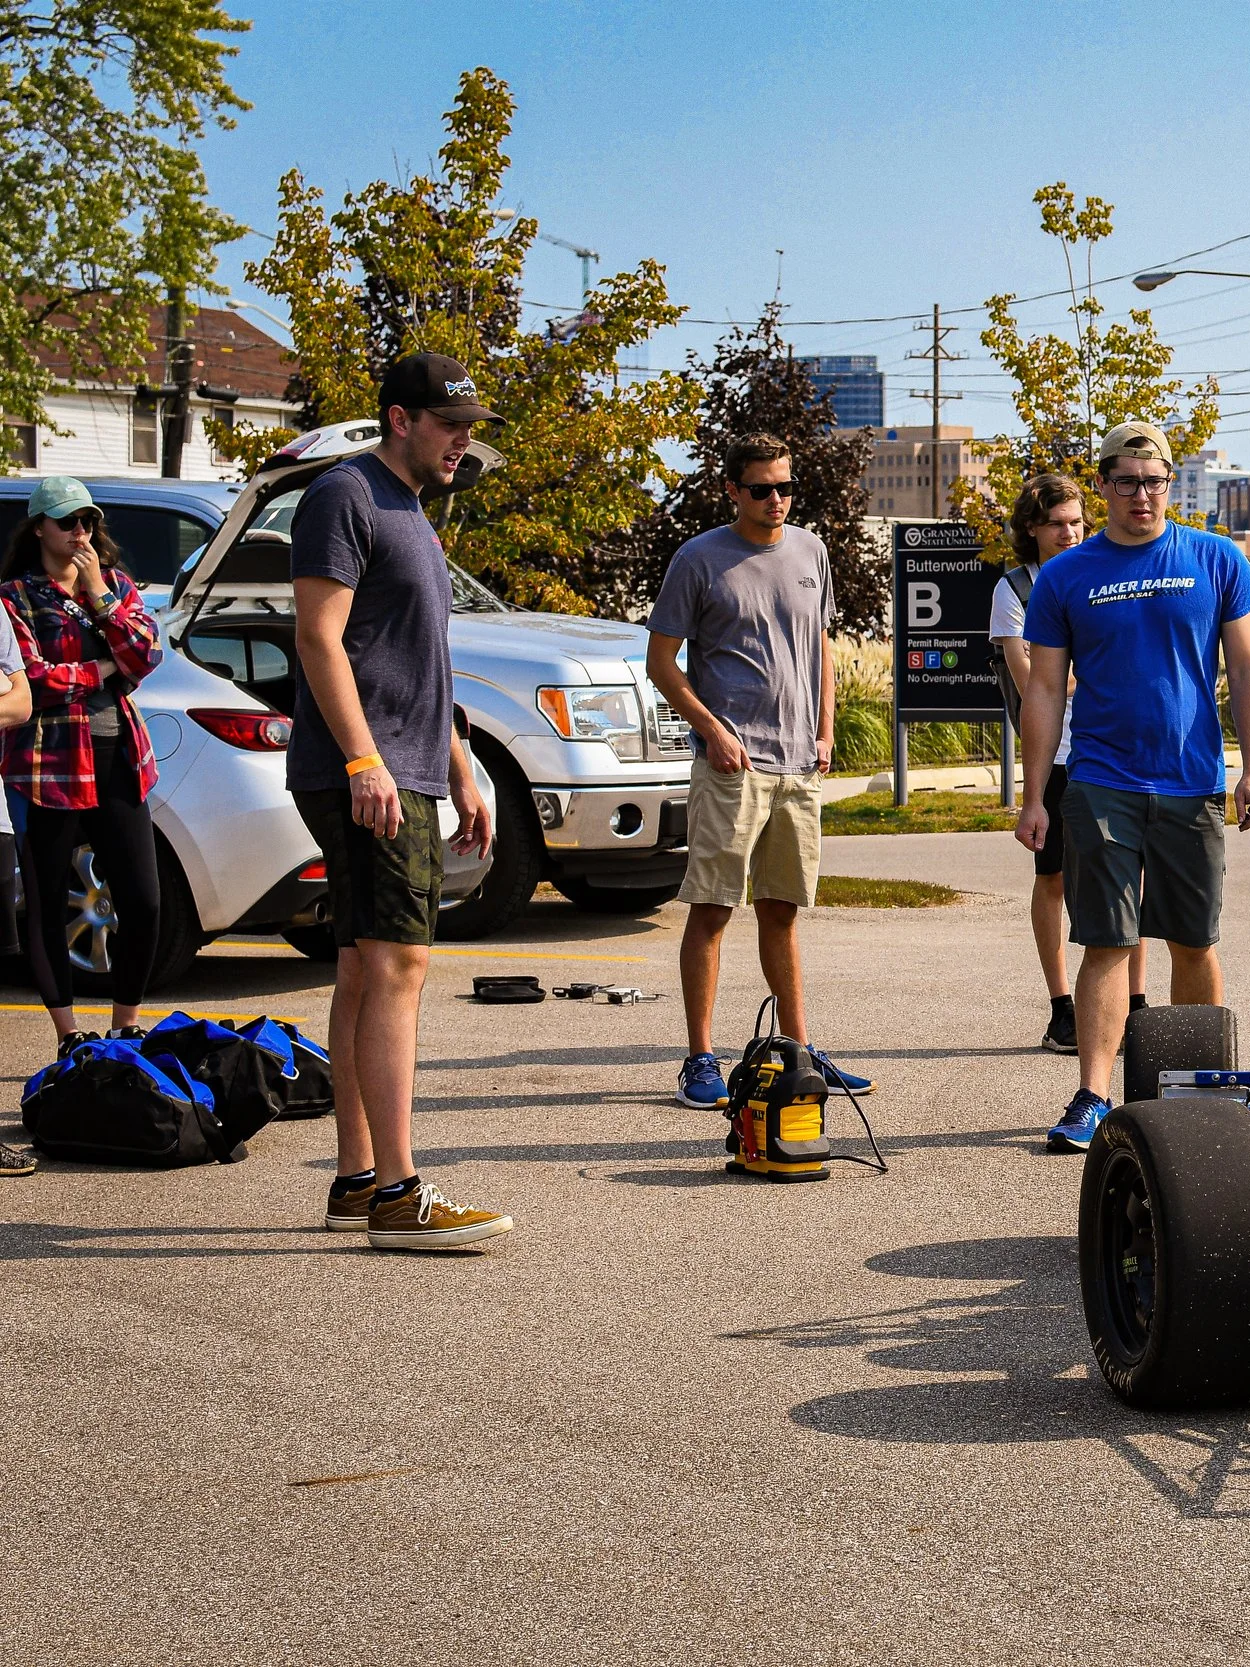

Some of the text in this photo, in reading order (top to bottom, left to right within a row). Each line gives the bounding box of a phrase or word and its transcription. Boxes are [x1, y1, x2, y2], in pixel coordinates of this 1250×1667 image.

[906, 559, 982, 573] Butterworth
[1088, 577, 1195, 598] LAKER RACING
[907, 582, 942, 628] B
[1091, 593, 1135, 606] FORMULA
[907, 638, 967, 650] Permit Required
[907, 673, 998, 685] No Overnight Parking
